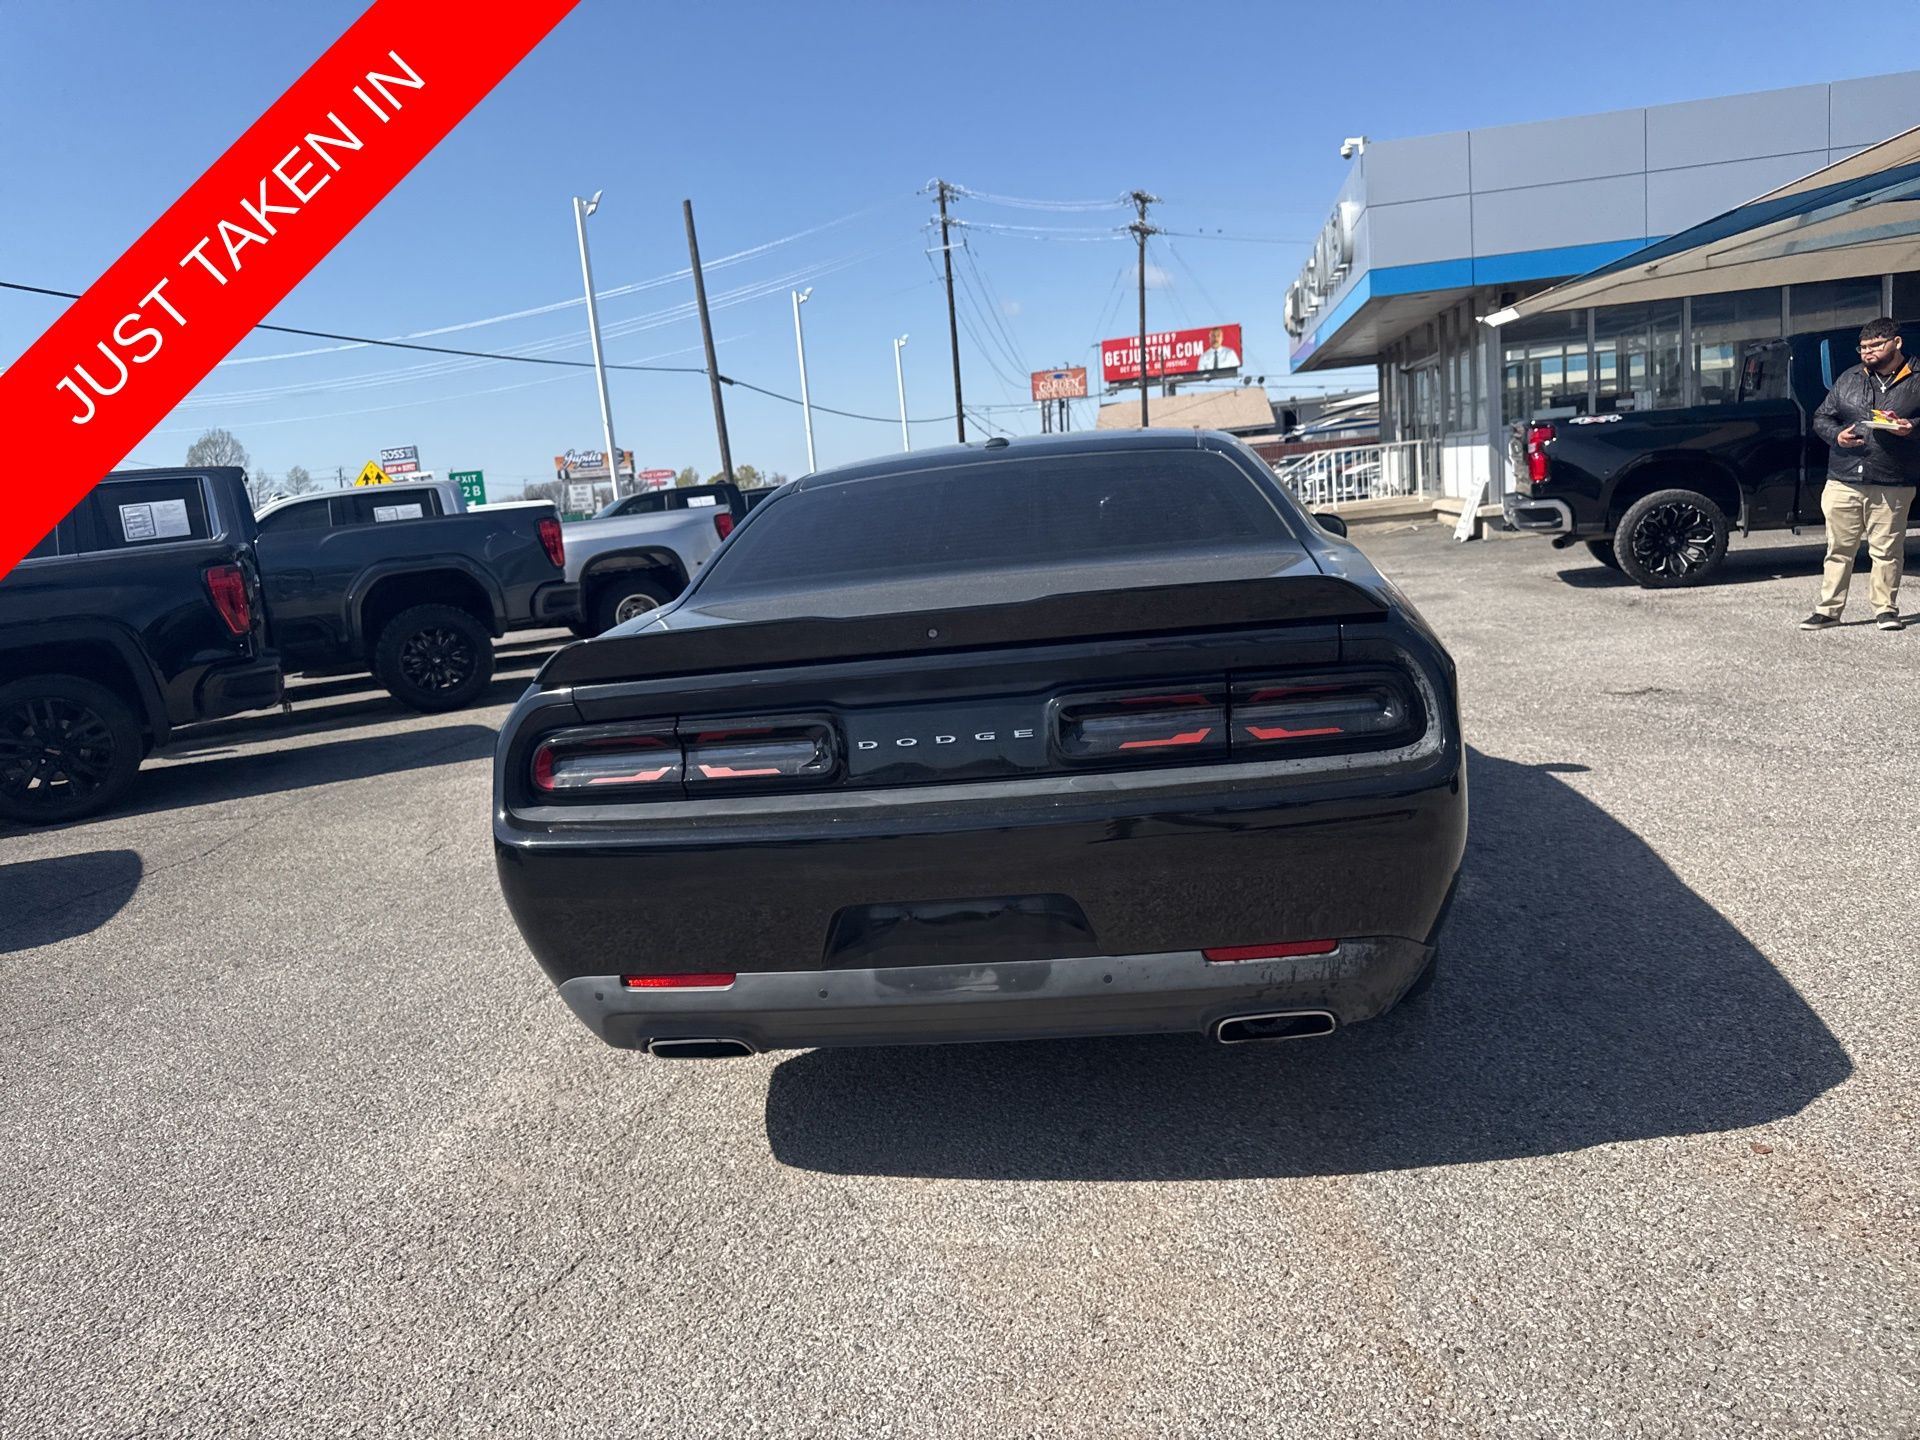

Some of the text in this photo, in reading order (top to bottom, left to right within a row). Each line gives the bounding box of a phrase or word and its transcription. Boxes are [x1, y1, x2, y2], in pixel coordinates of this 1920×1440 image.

[1129, 333, 1177, 347] INURED?
[382, 449, 405, 460] ROSS
[858, 729, 1033, 750] DODGE
